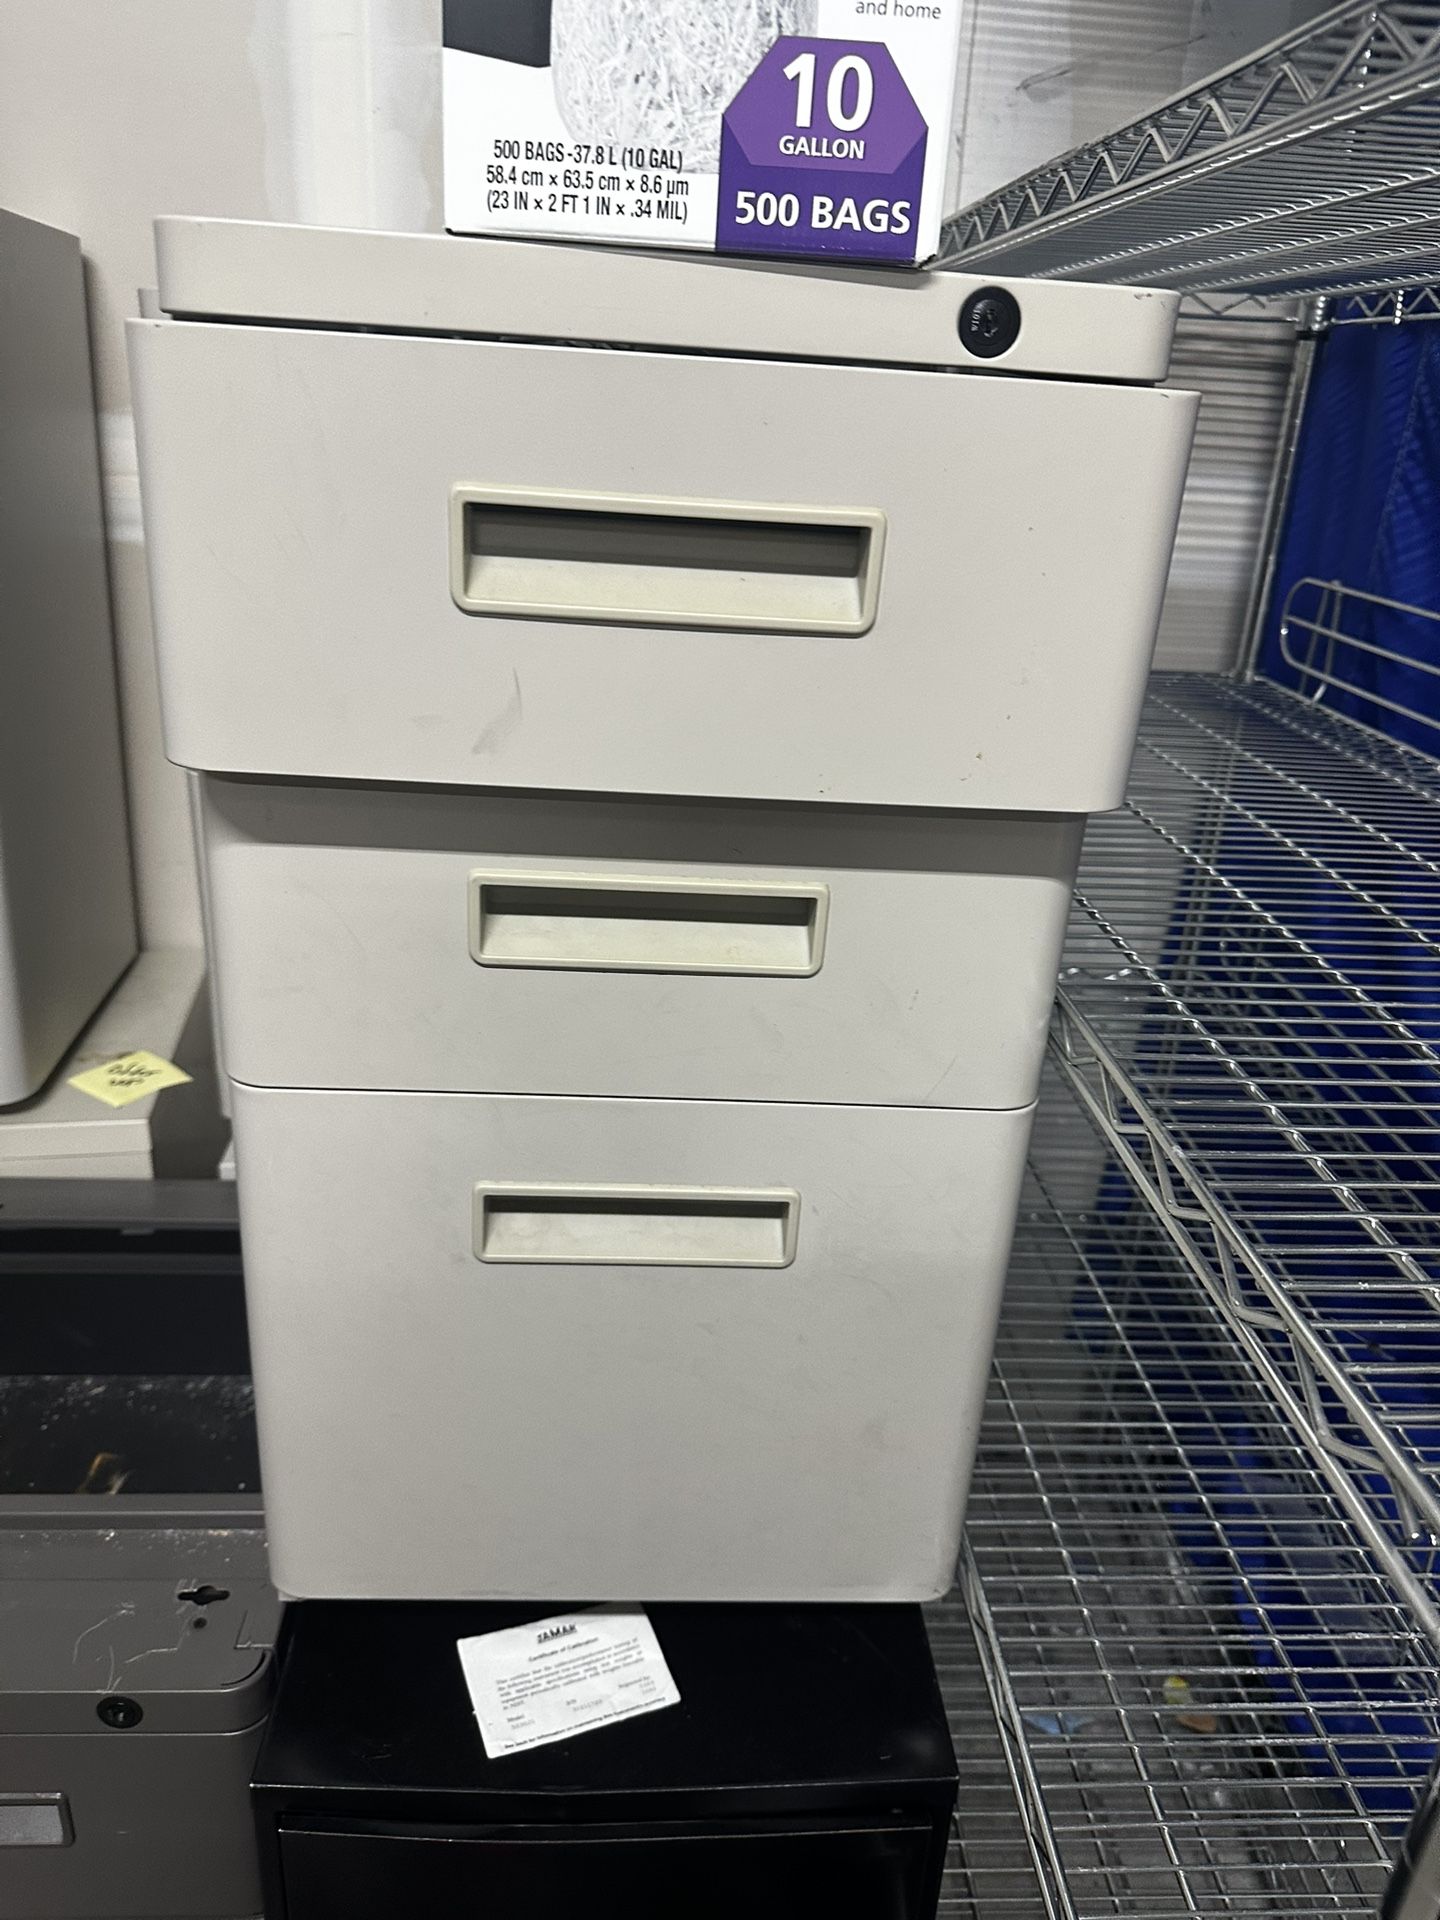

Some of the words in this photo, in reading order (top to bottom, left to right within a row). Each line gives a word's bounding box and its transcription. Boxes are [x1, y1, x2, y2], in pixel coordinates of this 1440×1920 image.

[856, 0, 888, 15] and
[893, 0, 942, 19] home
[783, 53, 874, 132] 10
[494, 140, 520, 159] 500
[525, 141, 564, 162] BAGS
[609, 147, 617, 166] L
[622, 147, 645, 172] (10
[649, 148, 683, 174] GAL)
[779, 135, 865, 159] GALLON
[486, 165, 517, 184] 58.4
[522, 171, 543, 186] cm
[563, 169, 594, 189] 63.5
[599, 175, 620, 191] cm
[640, 174, 662, 194] 8.6
[487, 189, 509, 212] (23
[514, 191, 528, 210] IN
[548, 194, 557, 212] 2
[561, 194, 578, 213] FT
[584, 196, 590, 214] 1
[596, 196, 611, 216] IN
[630, 199, 651, 218] .34
[656, 200, 688, 225] MIL)
[735, 190, 800, 227] 500
[811, 195, 911, 235] BAGS
